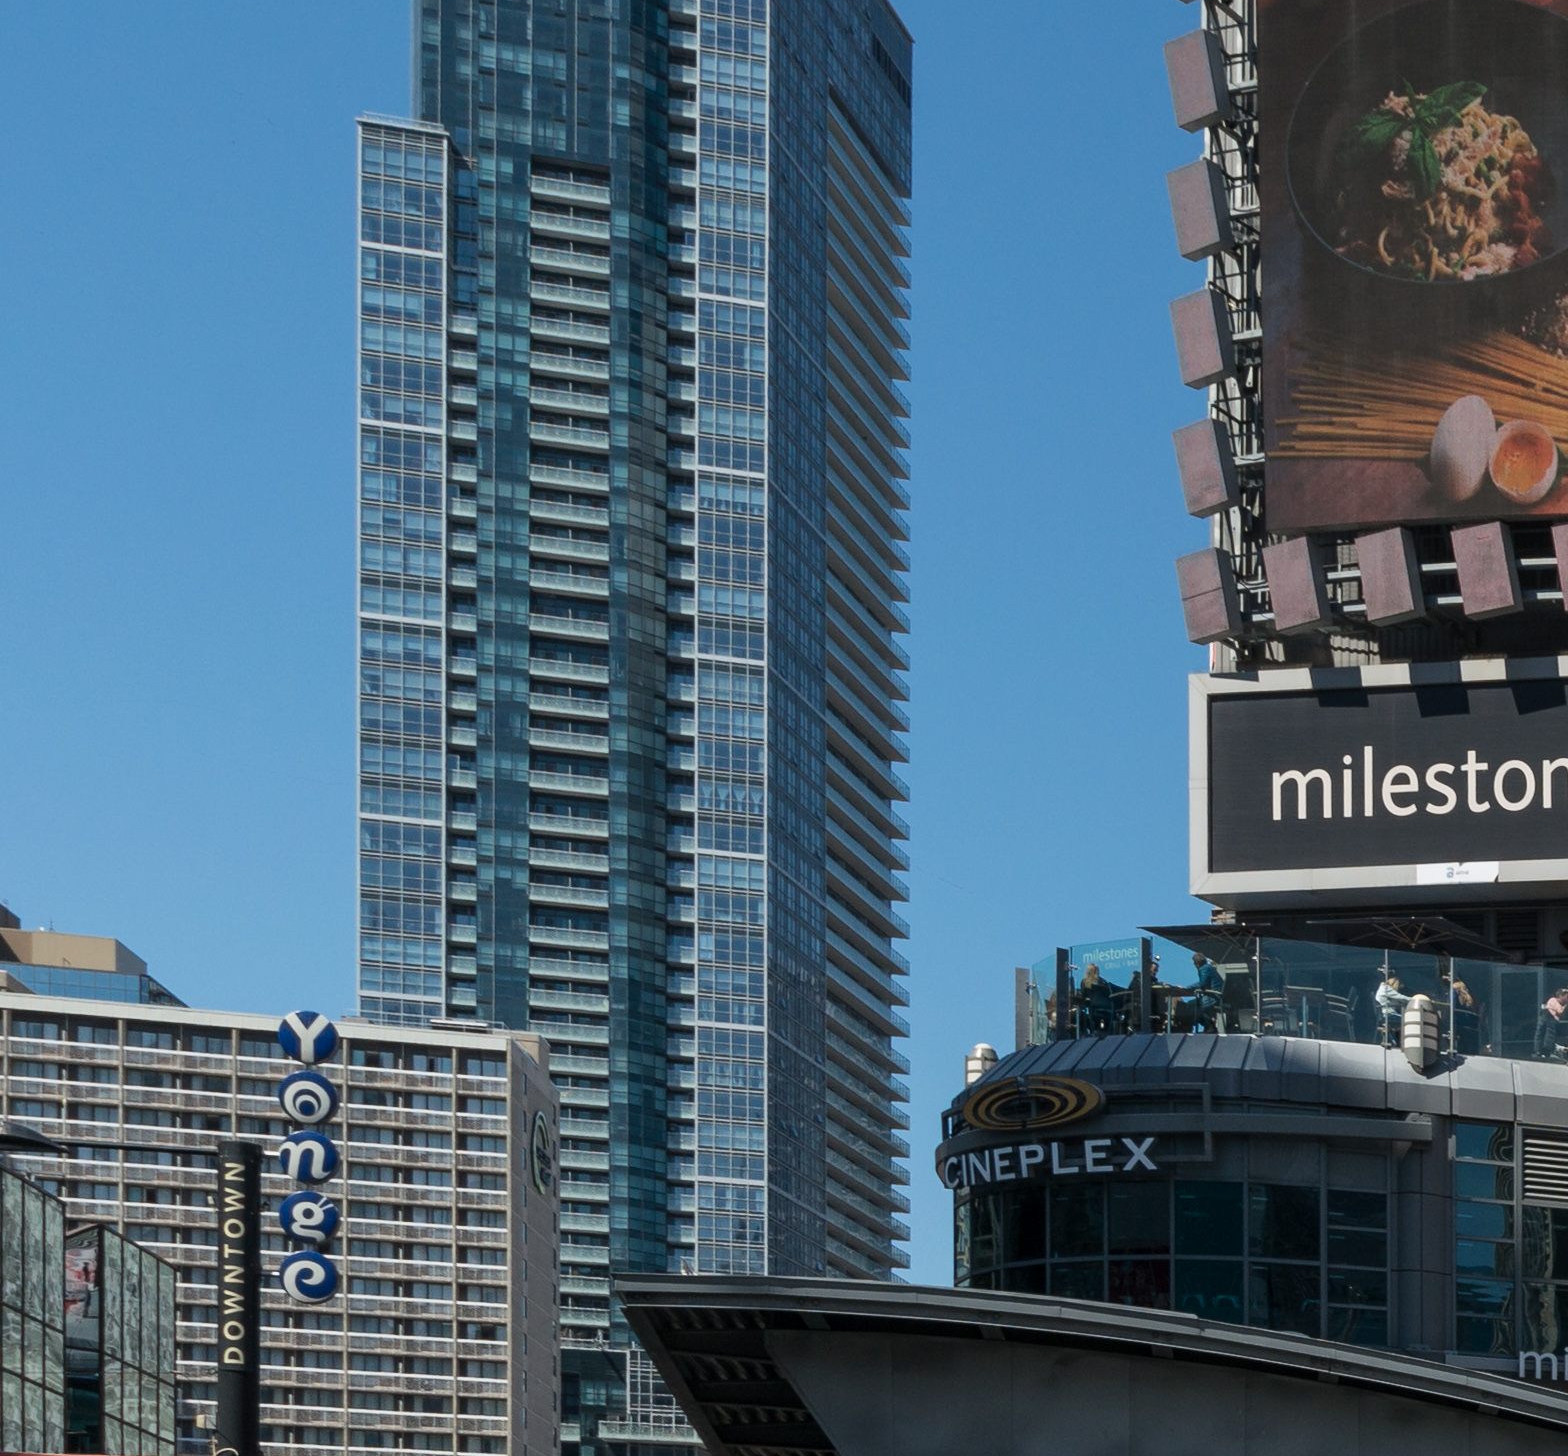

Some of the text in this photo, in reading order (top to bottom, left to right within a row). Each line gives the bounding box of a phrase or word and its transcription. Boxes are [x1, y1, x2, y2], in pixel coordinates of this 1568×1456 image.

[1083, 947, 1138, 962] milestones
[277, 1011, 337, 1303] Yonge
[944, 1136, 1158, 1189] CINEPLEX
[223, 1161, 246, 1365] DOWNTOWN
